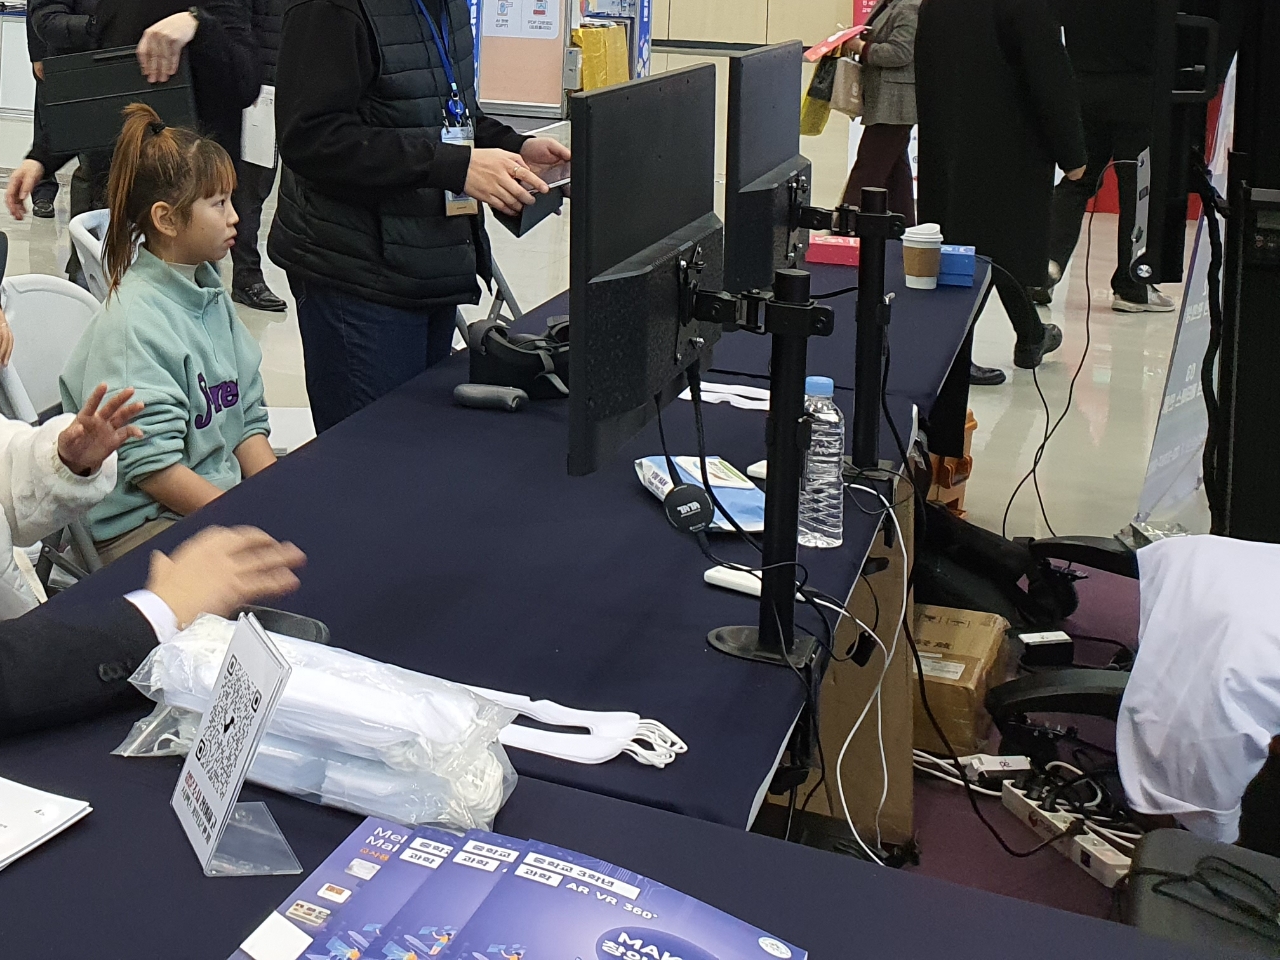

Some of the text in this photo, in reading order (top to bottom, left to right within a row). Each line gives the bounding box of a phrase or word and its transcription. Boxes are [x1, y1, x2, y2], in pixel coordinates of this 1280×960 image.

[408, 852, 436, 864] 과학
[472, 844, 512, 859] 중학교
[461, 855, 490, 867] 과학
[533, 857, 615, 888] 중학교 3학년
[523, 868, 658, 920] 과학 AR VR 360°
